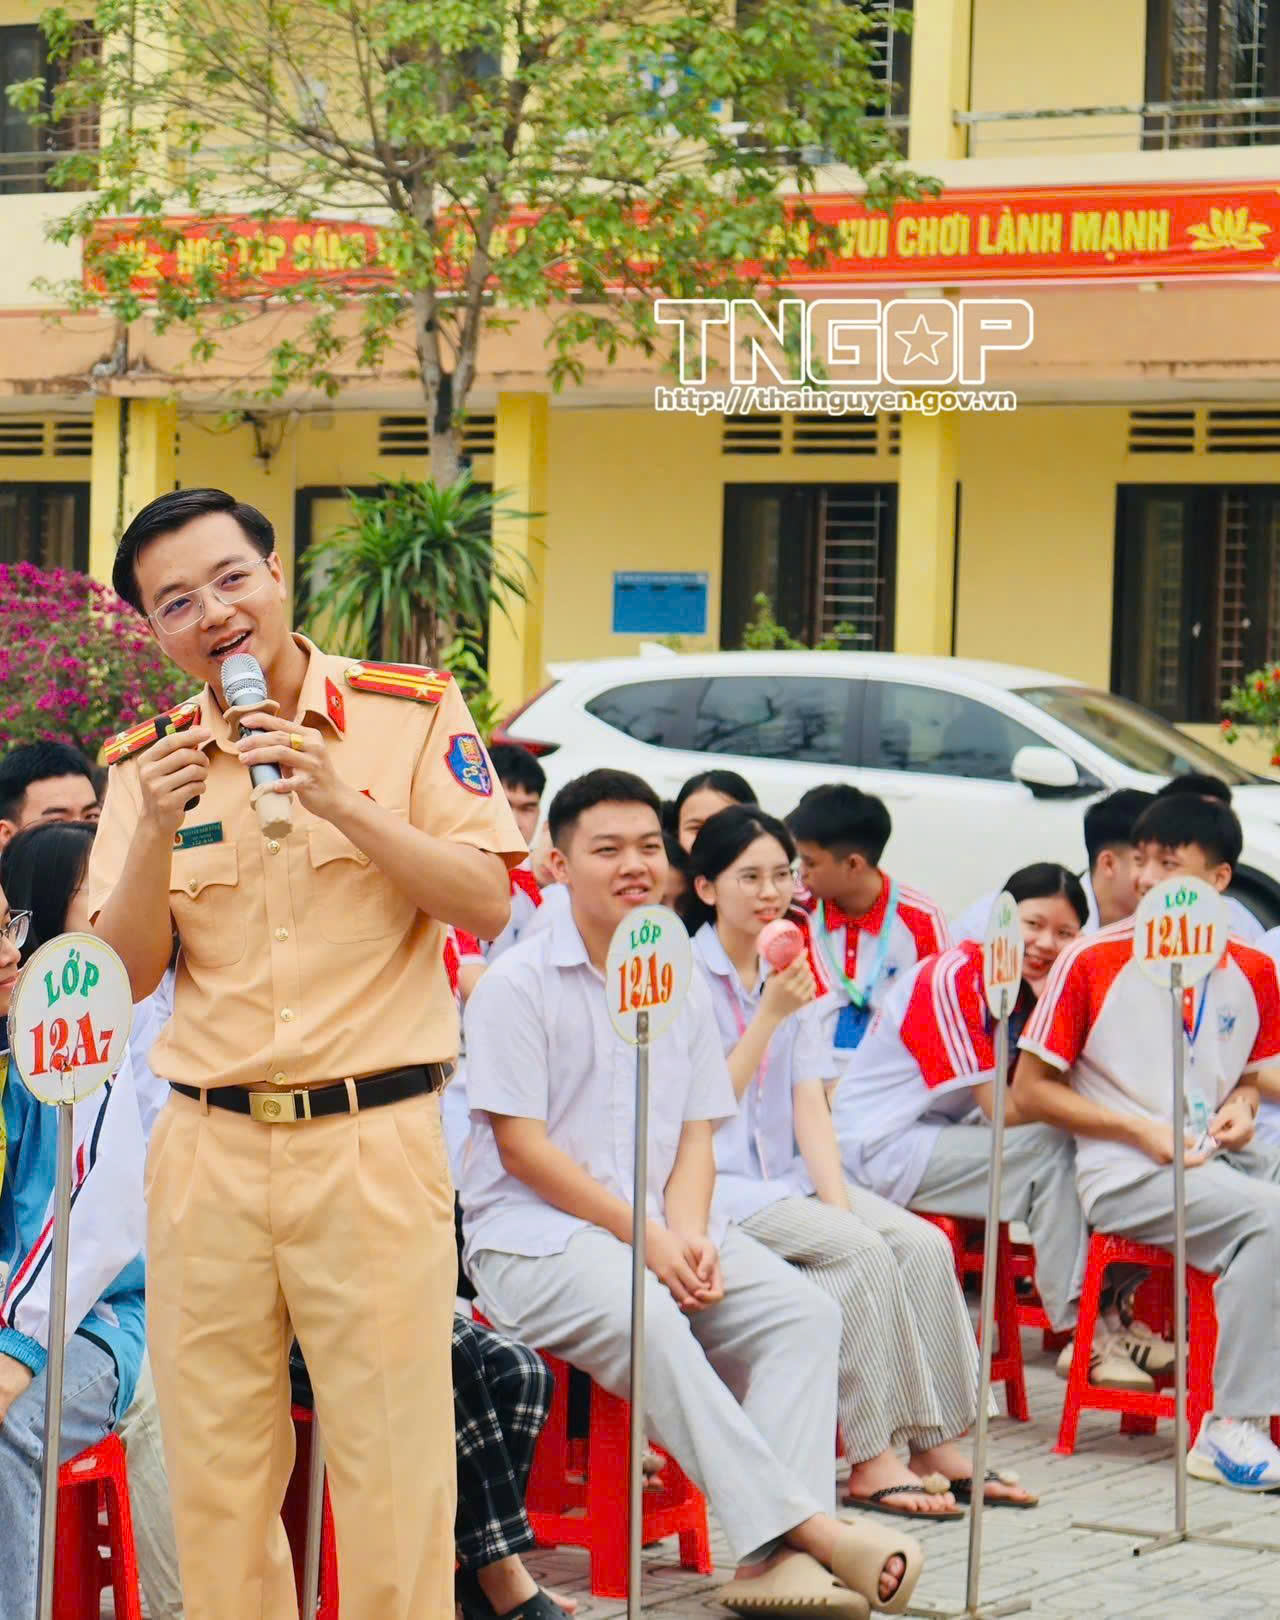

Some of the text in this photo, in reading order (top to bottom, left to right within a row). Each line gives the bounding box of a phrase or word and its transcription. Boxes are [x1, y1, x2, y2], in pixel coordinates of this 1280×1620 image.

[897, 212, 970, 258] CHƠI
[978, 205, 1063, 255] LÀNH
[1071, 208, 1170, 262] MẠNH
[1166, 887, 1198, 908] LỚP
[631, 919, 662, 950] LỚP
[1145, 912, 1216, 961] 12A11
[44, 948, 100, 1008] LỚP
[618, 951, 674, 1014] 12A9
[29, 1010, 115, 1076] 12A7
